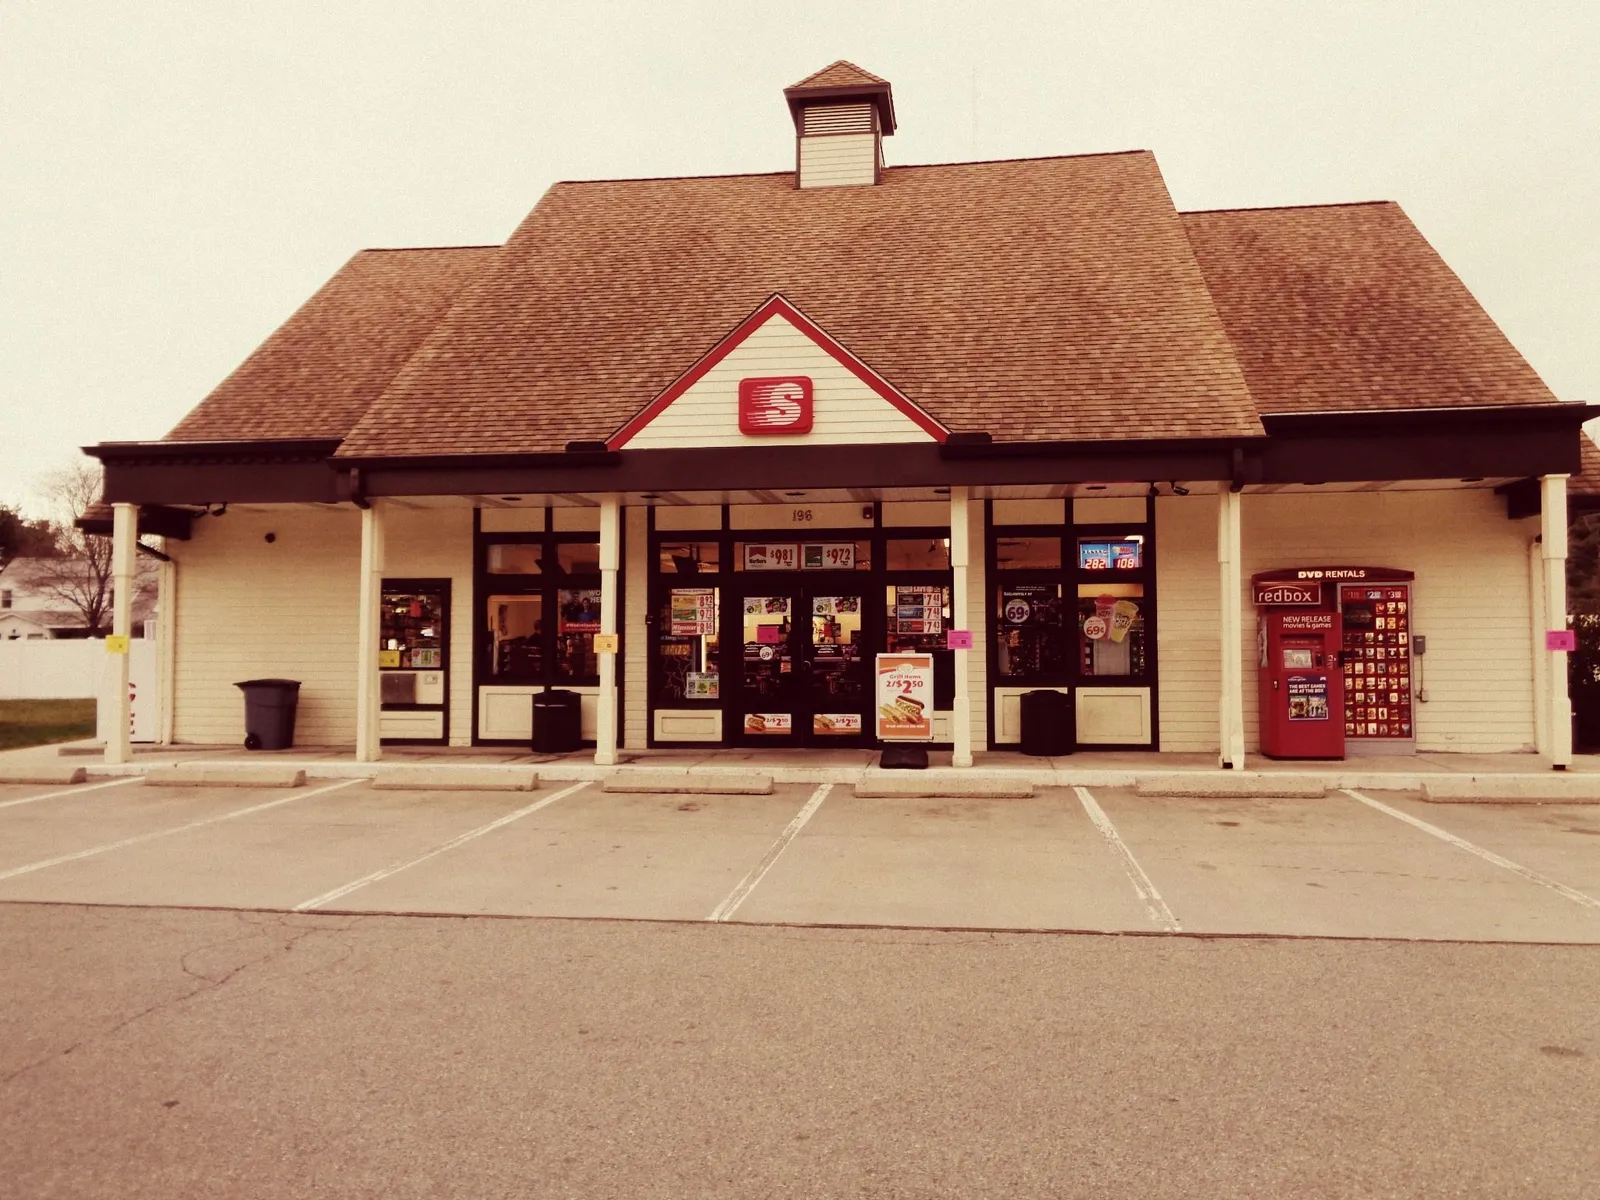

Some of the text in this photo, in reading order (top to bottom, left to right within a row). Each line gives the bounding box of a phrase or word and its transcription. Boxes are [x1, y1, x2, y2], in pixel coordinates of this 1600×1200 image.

[792, 509, 813, 522] 196
[1085, 559, 1106, 569] 282
[1117, 559, 1135, 569] 108
[1325, 570, 1366, 578] RENTALS
[1258, 589, 1312, 602] redbox
[1301, 615, 1332, 623] RELEASE
